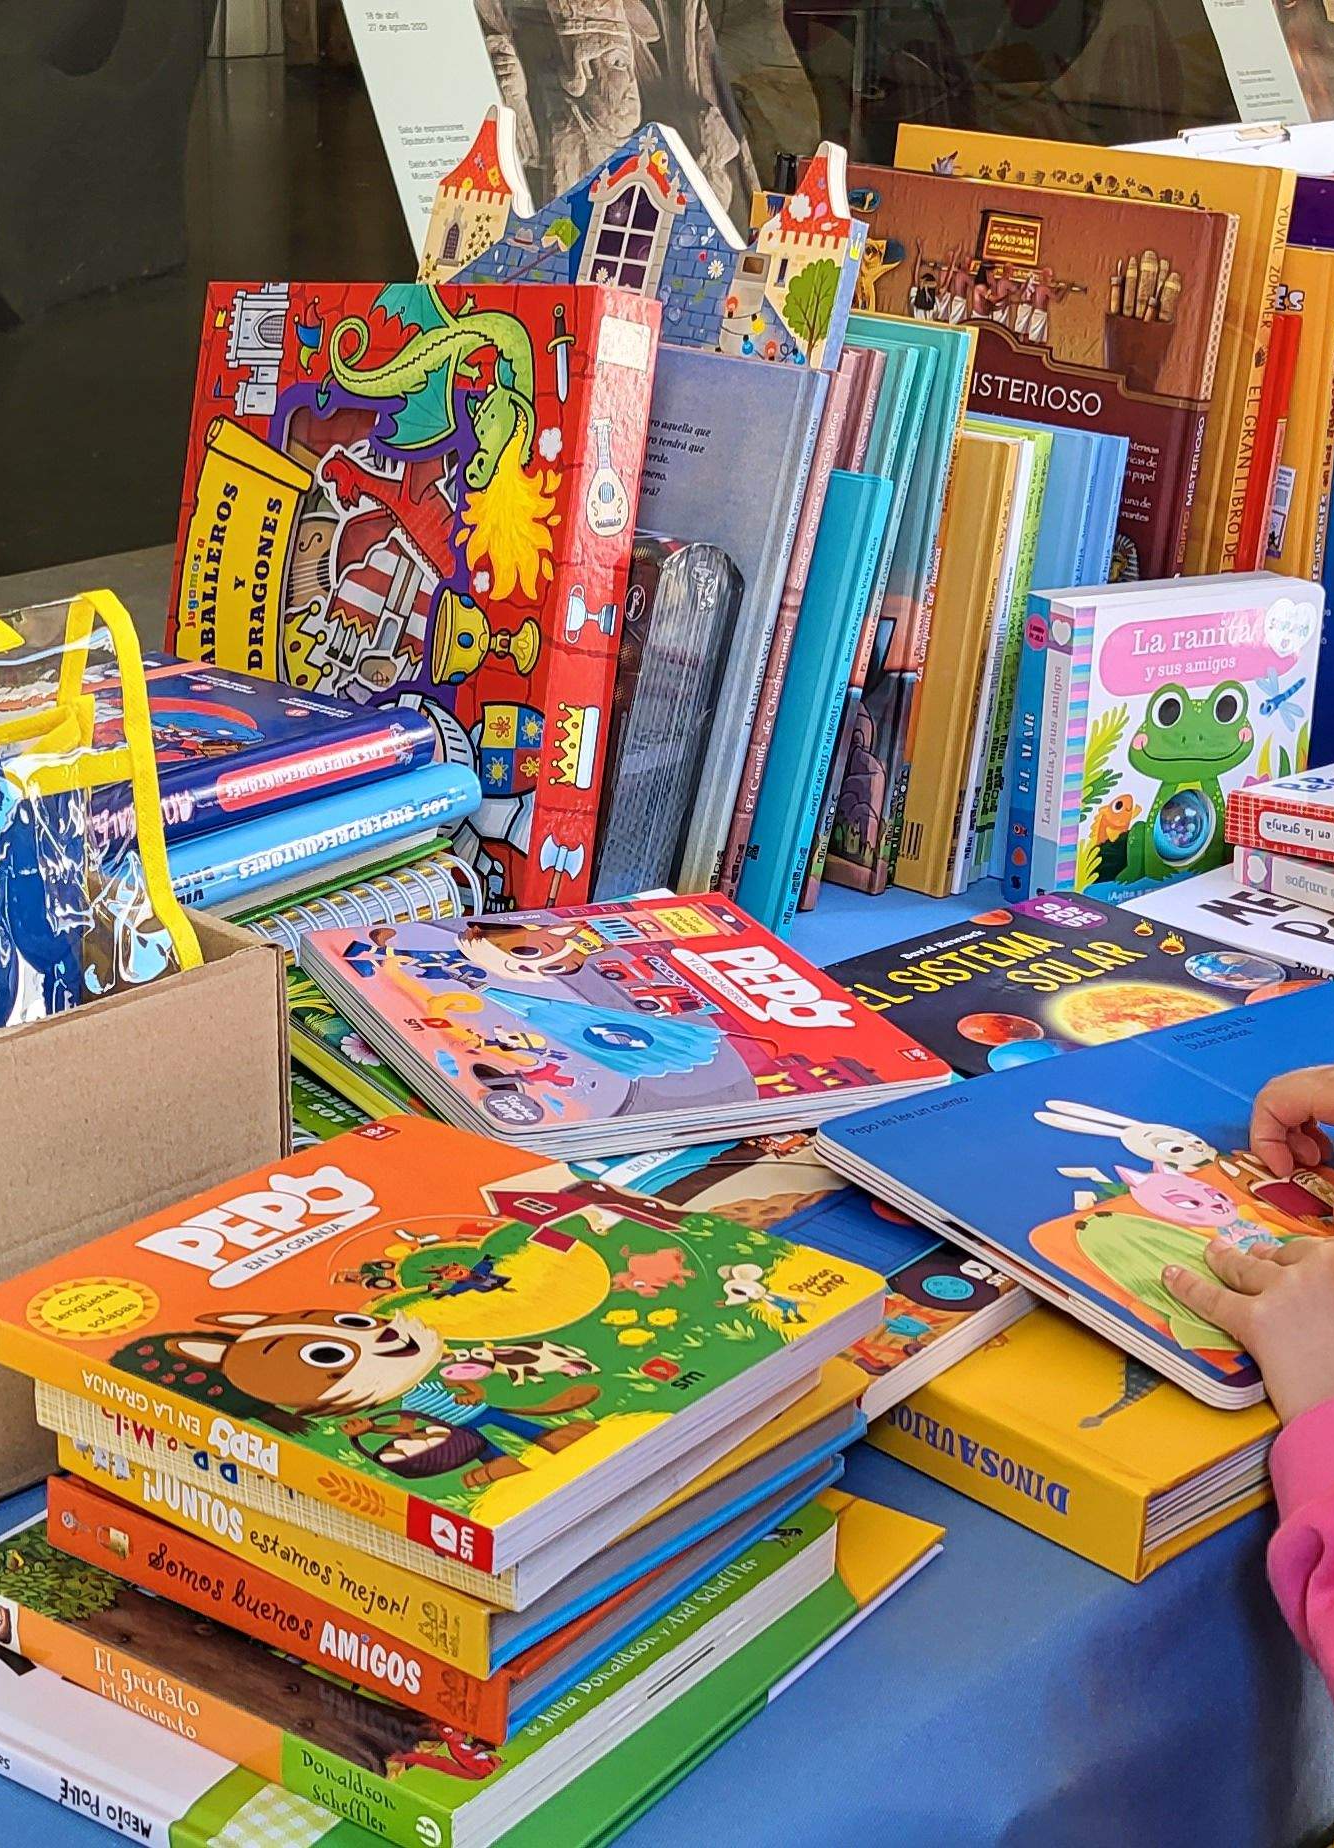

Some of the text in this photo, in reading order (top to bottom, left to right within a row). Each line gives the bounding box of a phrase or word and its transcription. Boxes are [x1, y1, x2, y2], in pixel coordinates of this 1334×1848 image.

[972, 372, 1102, 417] ISTERIOSO
[1222, 205, 1291, 562] YUVAL ZOMMER EL GRAN LIBRO DE
[658, 437, 706, 454] tendrá que
[661, 420, 712, 439] aquella que
[1185, 417, 1205, 507] MISTERIOSO
[185, 537, 206, 629] Jugamos a
[200, 482, 240, 665] ABALLEROS
[233, 575, 246, 591] Y
[247, 497, 283, 671] DRAGONES
[1131, 627, 1165, 656] La
[1171, 618, 1255, 653] ranita
[1144, 657, 1237, 682] y sus amigos
[1017, 711, 1036, 793] EL MAR
[1043, 759, 1057, 806] ranita
[1050, 665, 1064, 719] amigos
[1265, 820, 1300, 834] granja
[1304, 828, 1314, 840] la
[1318, 830, 1331, 840] en
[1284, 873, 1329, 896] amigos
[1035, 902, 1061, 915] 10
[1044, 906, 1085, 923] POP
[1061, 911, 1104, 929] UPS
[886, 930, 1066, 993] SISTEMA
[1006, 940, 1149, 993] SOLAR
[706, 945, 857, 1029] PEPO
[307, 1102, 346, 1124] LOS
[845, 1122, 879, 1138] Pepo
[879, 1116, 894, 1128] les
[913, 1107, 929, 1118] un
[133, 1165, 376, 1272] PEPO
[241, 1221, 345, 1272] EN LA GRANJA
[49, 1289, 120, 1324] lengüetas
[58, 1291, 86, 1308] Con
[87, 1302, 139, 1330] solapas
[82, 1369, 149, 1413] GRANJA
[670, 1369, 707, 1392] sm
[155, 1403, 175, 1427] LA
[177, 1414, 201, 1436] EN
[208, 1417, 280, 1477] PEPO
[887, 1404, 1071, 1517] DINOSAURIOS
[142, 1470, 411, 1622] ¡JUNTOS estamos mejor!
[459, 1527, 475, 1563] sm
[147, 1543, 226, 1602] Somos
[230, 1577, 314, 1642] buenos
[522, 1722, 543, 1738] de
[536, 1695, 581, 1728] Julia
[575, 1634, 660, 1695] Donaldson
[668, 1600, 701, 1630] Axel
[695, 1558, 758, 1606] Scheffler
[93, 1646, 201, 1718] El grúfalo
[99, 1677, 198, 1740] Minicuento
[299, 1747, 398, 1812] Donaldson
[311, 1782, 389, 1835] Scheffler
